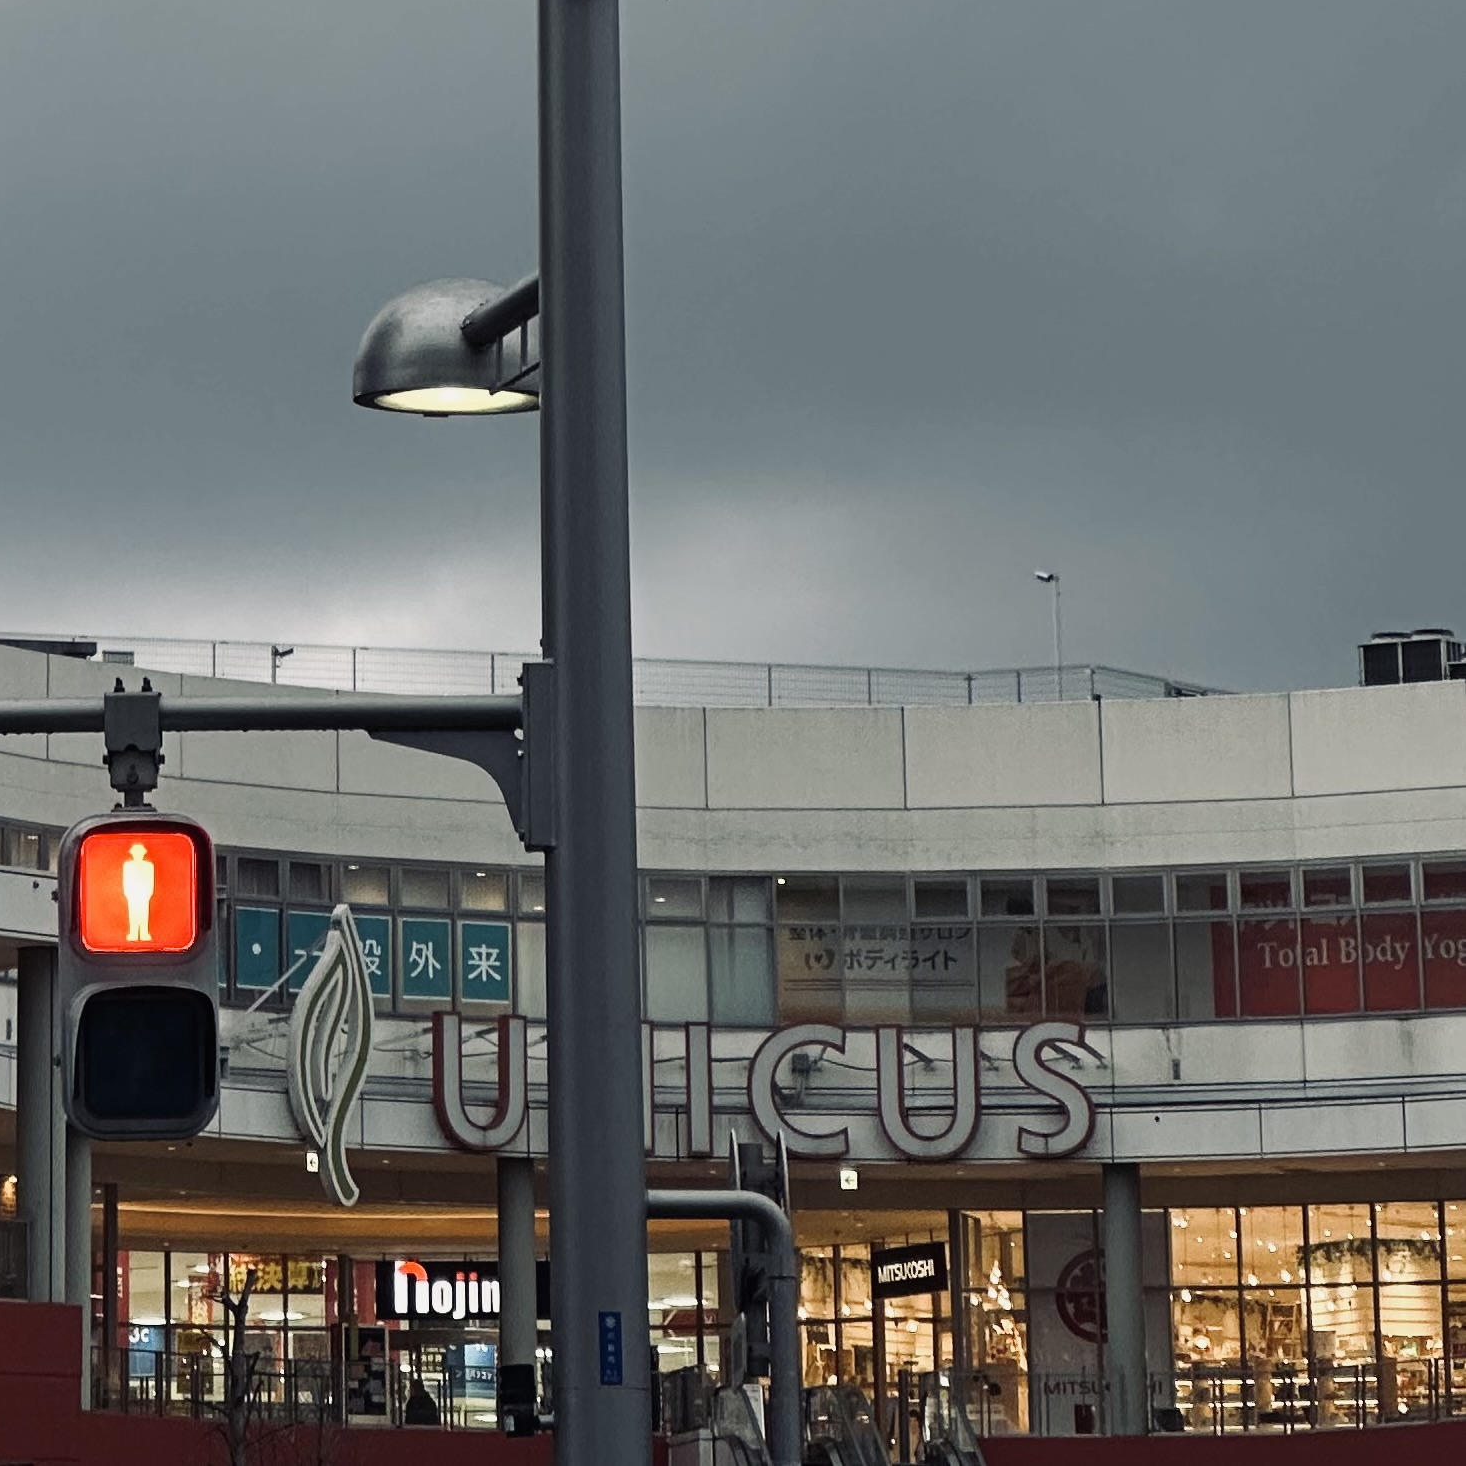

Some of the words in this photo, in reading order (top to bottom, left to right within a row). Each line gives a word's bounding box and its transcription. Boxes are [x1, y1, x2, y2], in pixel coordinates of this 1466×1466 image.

[1257, 938, 1330, 969] Total
[1338, 935, 1411, 971] Body
[433, 1011, 1097, 1161] UICUS
[878, 1258, 935, 1283] MITSUKOSHI
